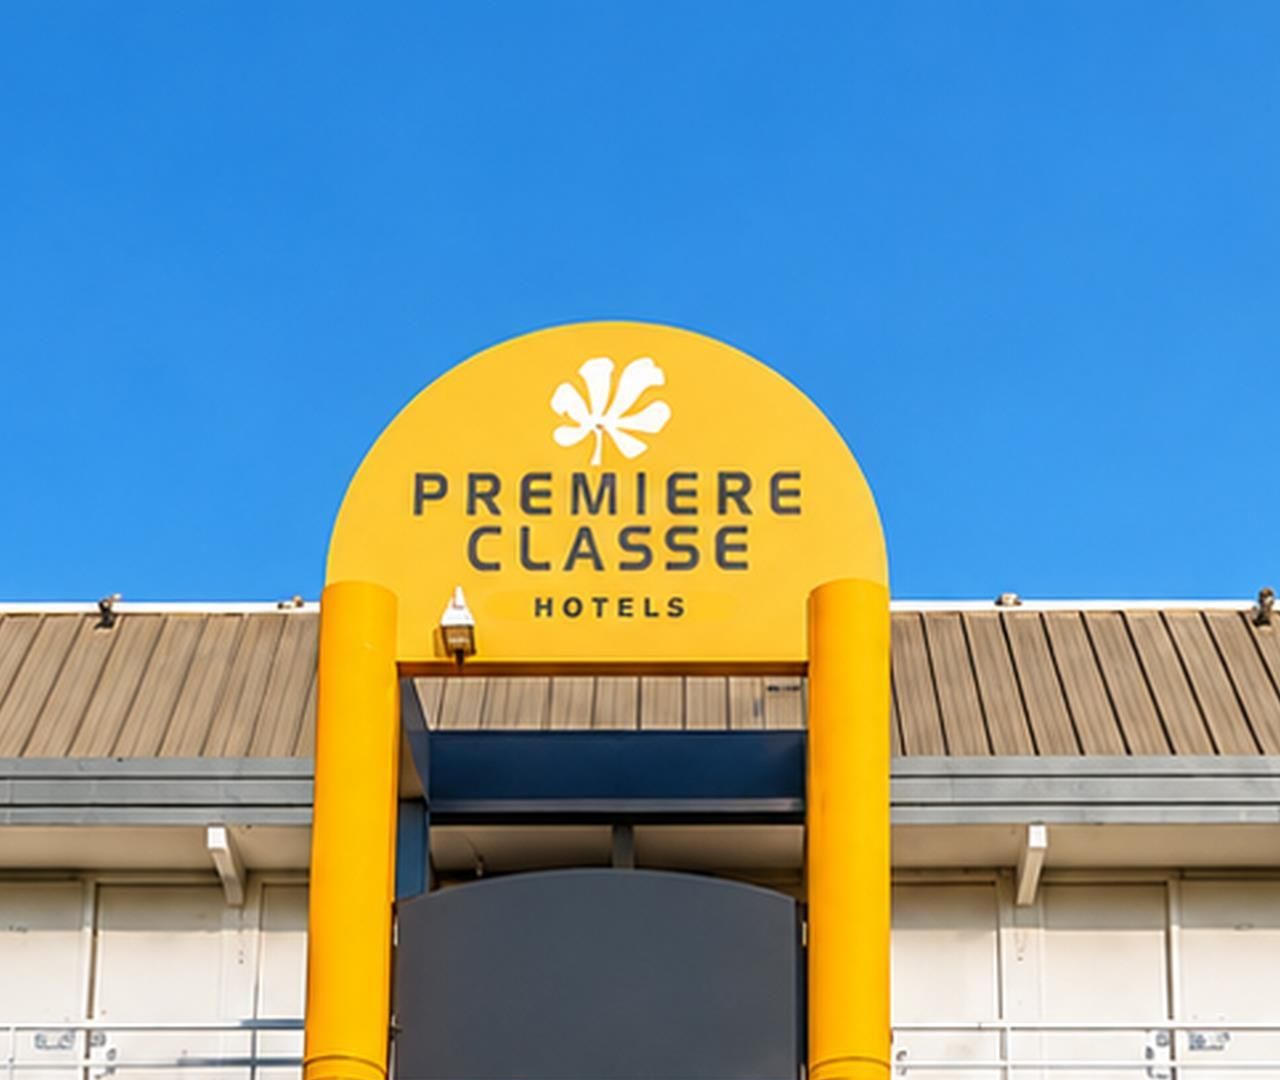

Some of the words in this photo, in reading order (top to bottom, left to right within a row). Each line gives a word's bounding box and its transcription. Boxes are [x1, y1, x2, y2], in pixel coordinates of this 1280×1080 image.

[413, 471, 802, 517] PREMIERE
[467, 524, 749, 572] CLASSE
[534, 596, 686, 619] HOTELS
